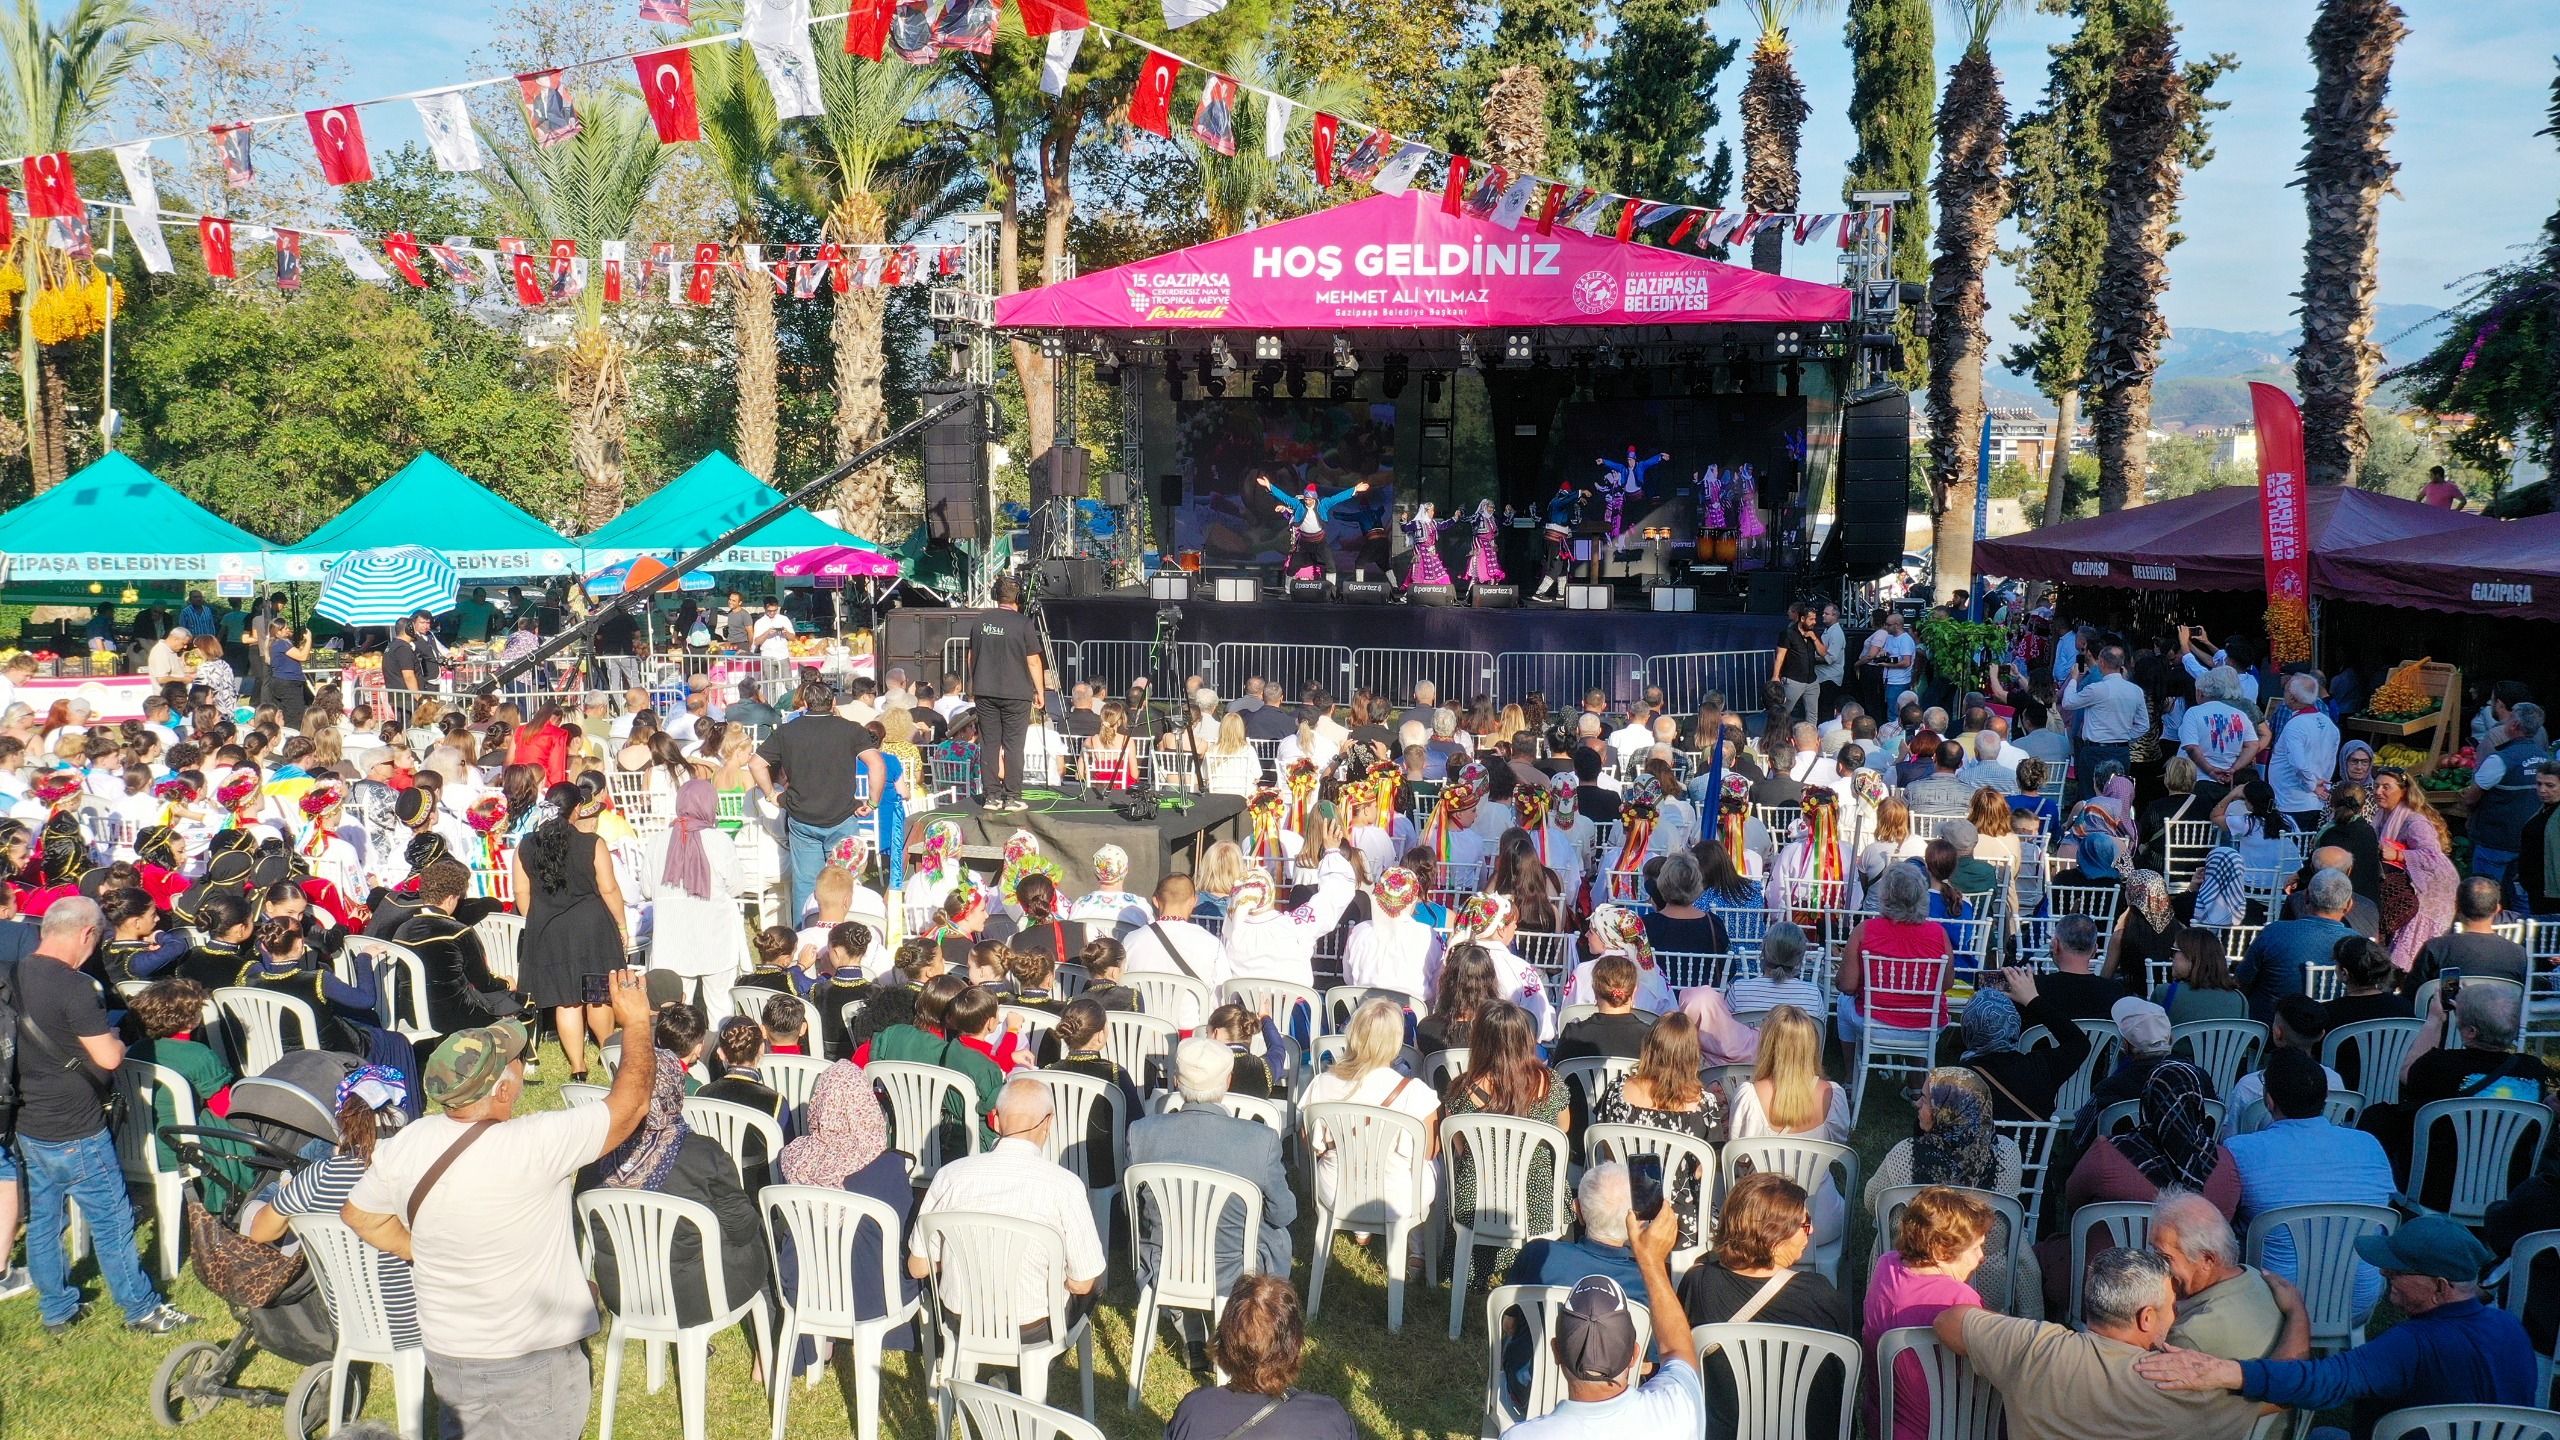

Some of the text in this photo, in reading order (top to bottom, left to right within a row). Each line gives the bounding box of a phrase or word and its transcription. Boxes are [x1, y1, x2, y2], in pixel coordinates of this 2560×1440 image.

[1253, 234, 1560, 281] HOŞ GELDİNİZ
[1625, 277, 1709, 296] GAZİPAŞA
[1198, 296, 1230, 305] MEYVE
[1315, 287, 1490, 304] MEHMET ALİ YILMAZ
[1624, 294, 1708, 312] BELEDİYESİ
[1145, 305, 1228, 321] festivali
[1335, 307, 1467, 318] Gazipaşa Belediye Başkanı
[8, 553, 206, 574] ZİPAŞA BELEDİYESİ
[783, 565, 801, 574] Golf
[824, 564, 847, 574] Golf
[872, 565, 889, 574] Golf
[2072, 558, 2176, 581] GAZİPAŞA BELEDİYESİ
[2471, 578, 2533, 606] GAZİPAŞA
